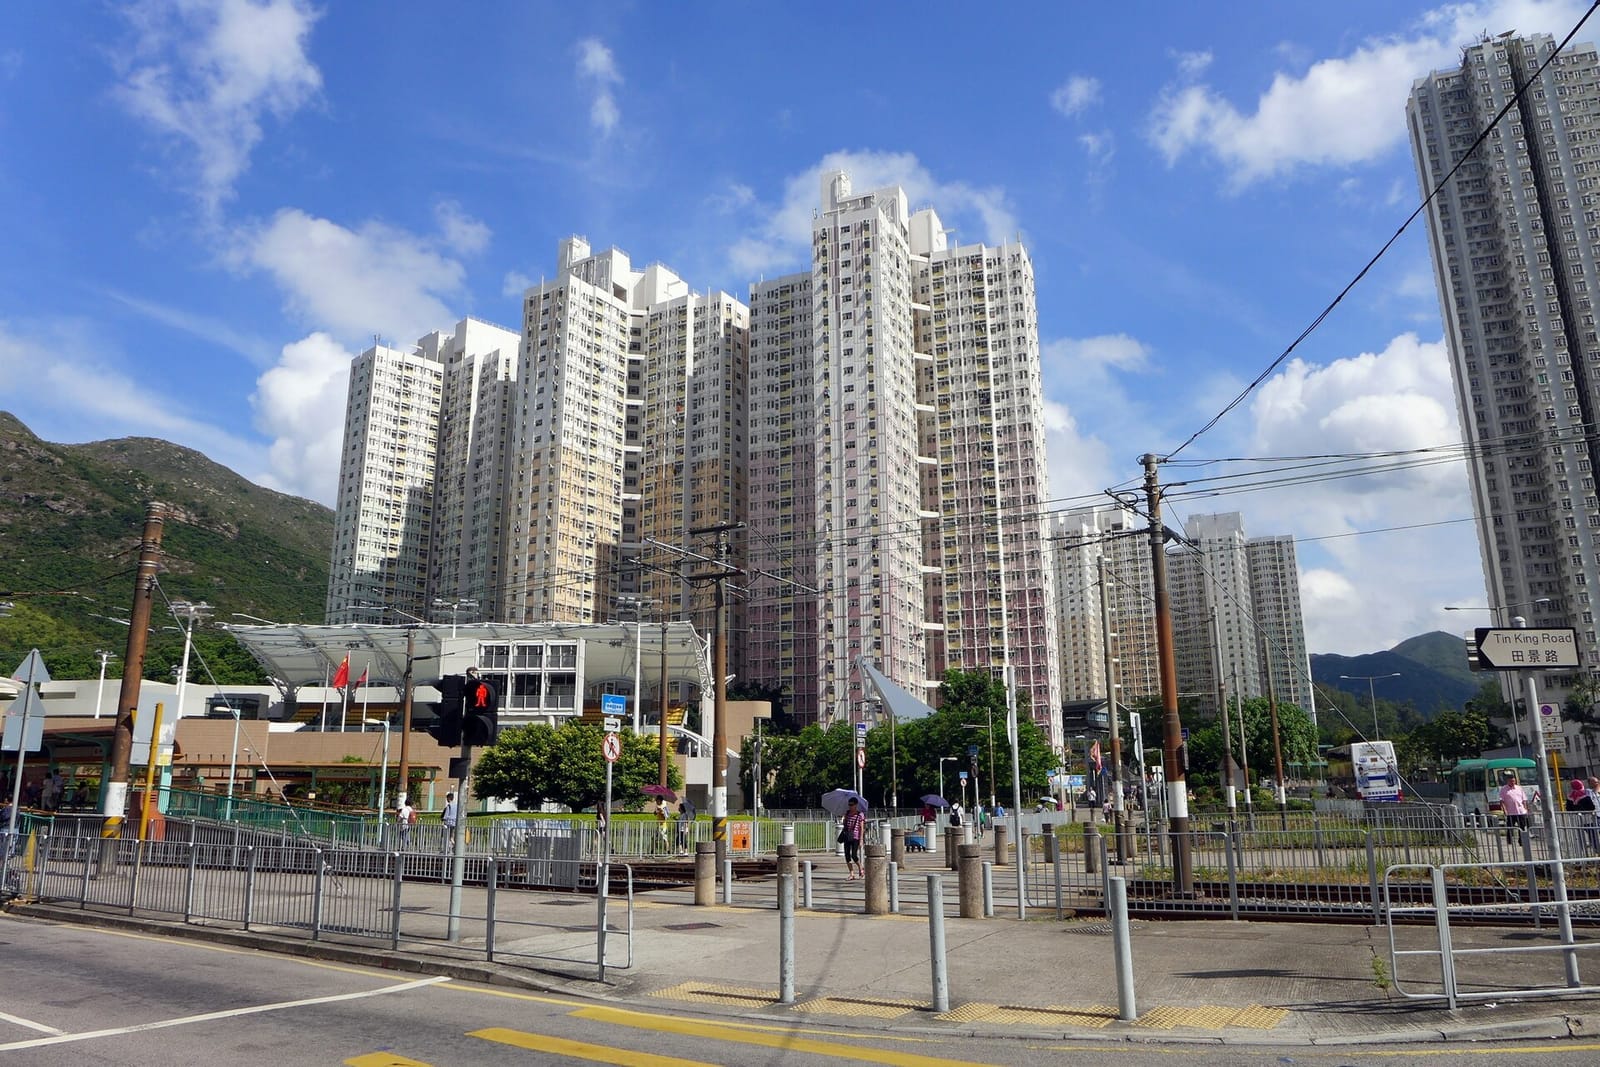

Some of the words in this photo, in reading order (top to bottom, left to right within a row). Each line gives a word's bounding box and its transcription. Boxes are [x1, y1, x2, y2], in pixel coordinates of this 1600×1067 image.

[1494, 633, 1511, 643] Tin
[1514, 633, 1539, 645] King
[1542, 633, 1572, 643] Road
[1512, 649, 1558, 662] 田景路
